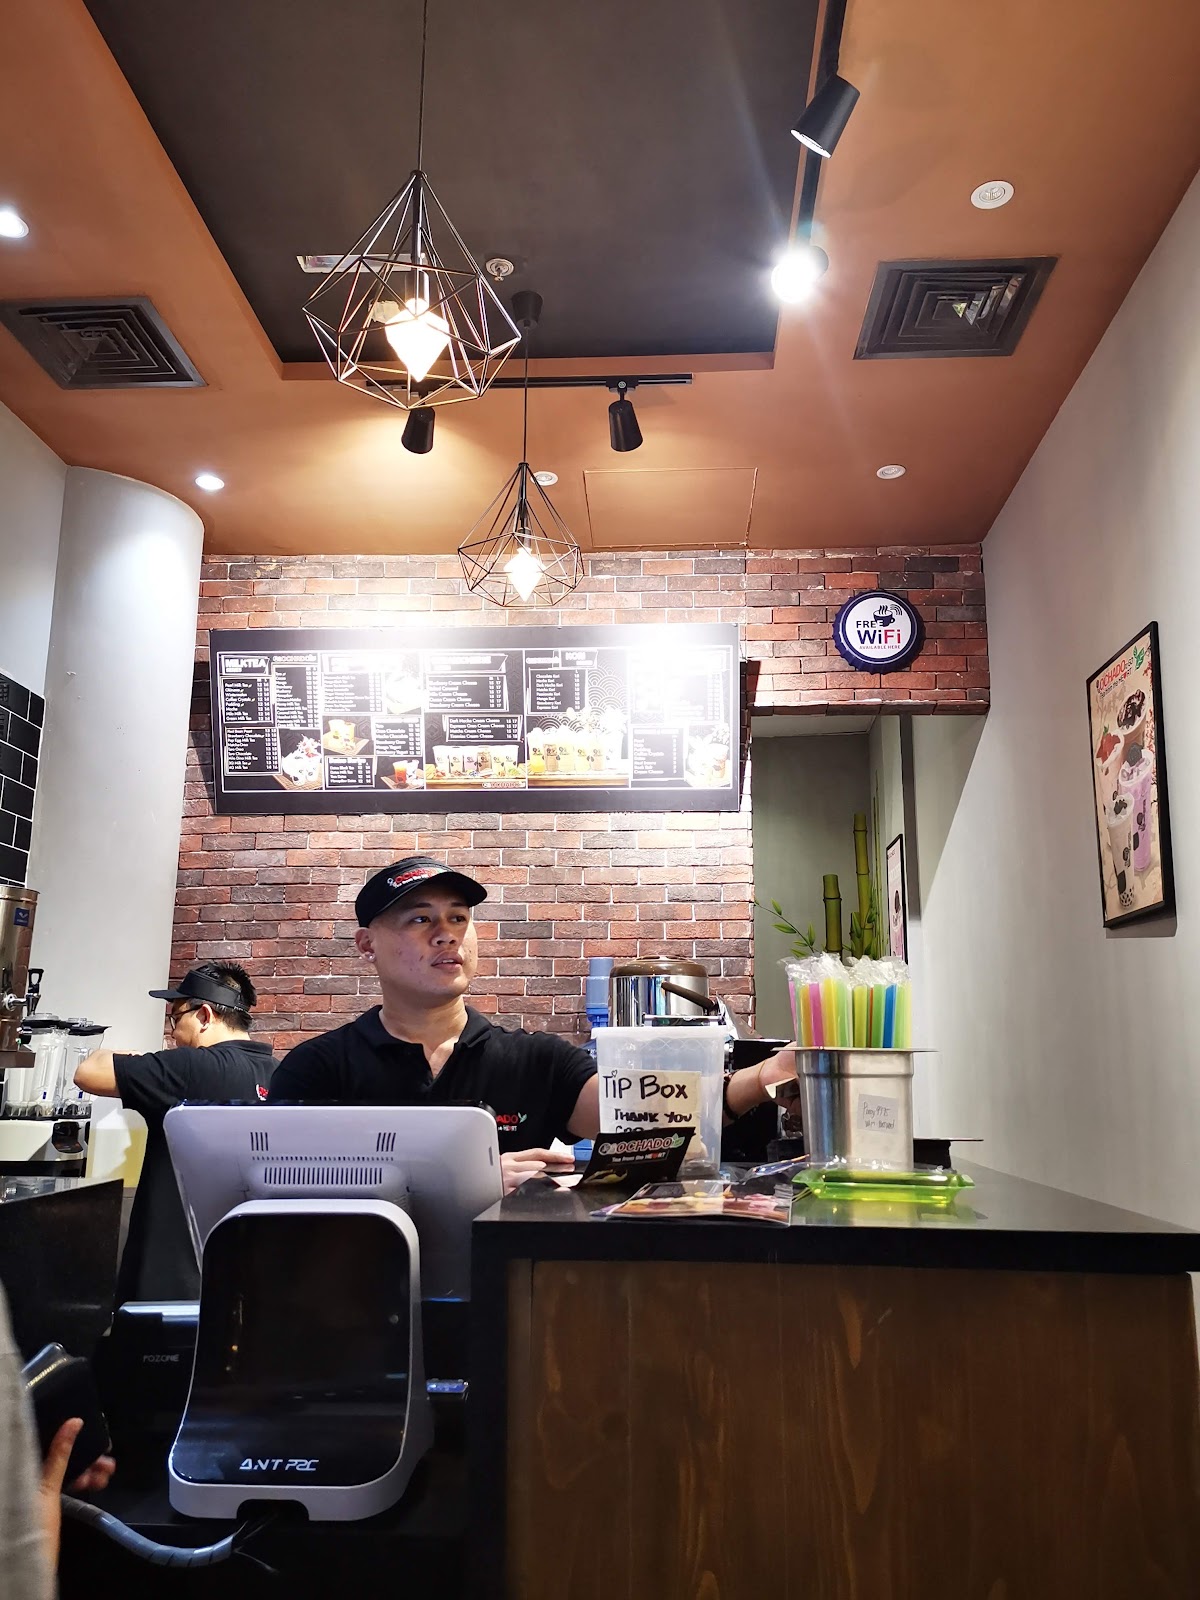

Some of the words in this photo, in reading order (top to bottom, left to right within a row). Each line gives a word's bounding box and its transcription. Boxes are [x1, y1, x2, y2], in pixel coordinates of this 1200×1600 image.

[856, 620, 884, 628] FREE
[857, 629, 901, 645] WiFi
[615, 1109, 659, 1122] THANK
[664, 1112, 693, 1123] YOU
